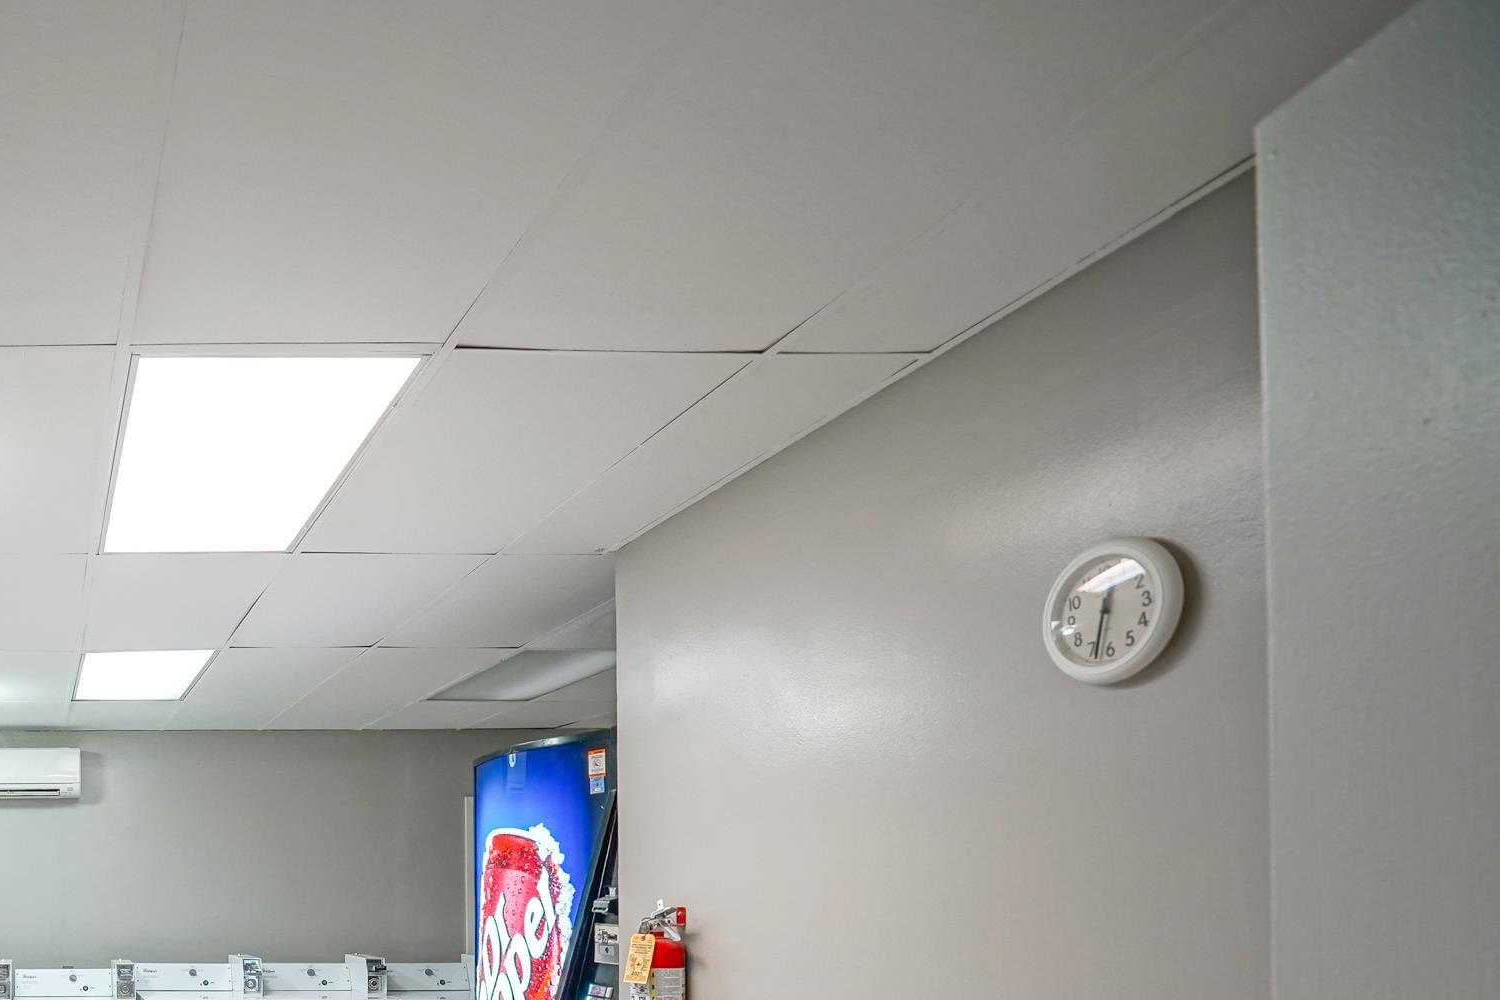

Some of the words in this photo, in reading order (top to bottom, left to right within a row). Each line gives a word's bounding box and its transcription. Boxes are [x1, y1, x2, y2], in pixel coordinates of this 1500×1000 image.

[1134, 574, 1145, 589] 2
[1068, 595, 1081, 611] 10
[1141, 590, 1152, 607] 3
[1138, 611, 1149, 627] 4
[1074, 632, 1083, 647] 8
[1125, 630, 1135, 647] 5
[1087, 641, 1097, 657] 7
[1105, 642, 1115, 657] 6
